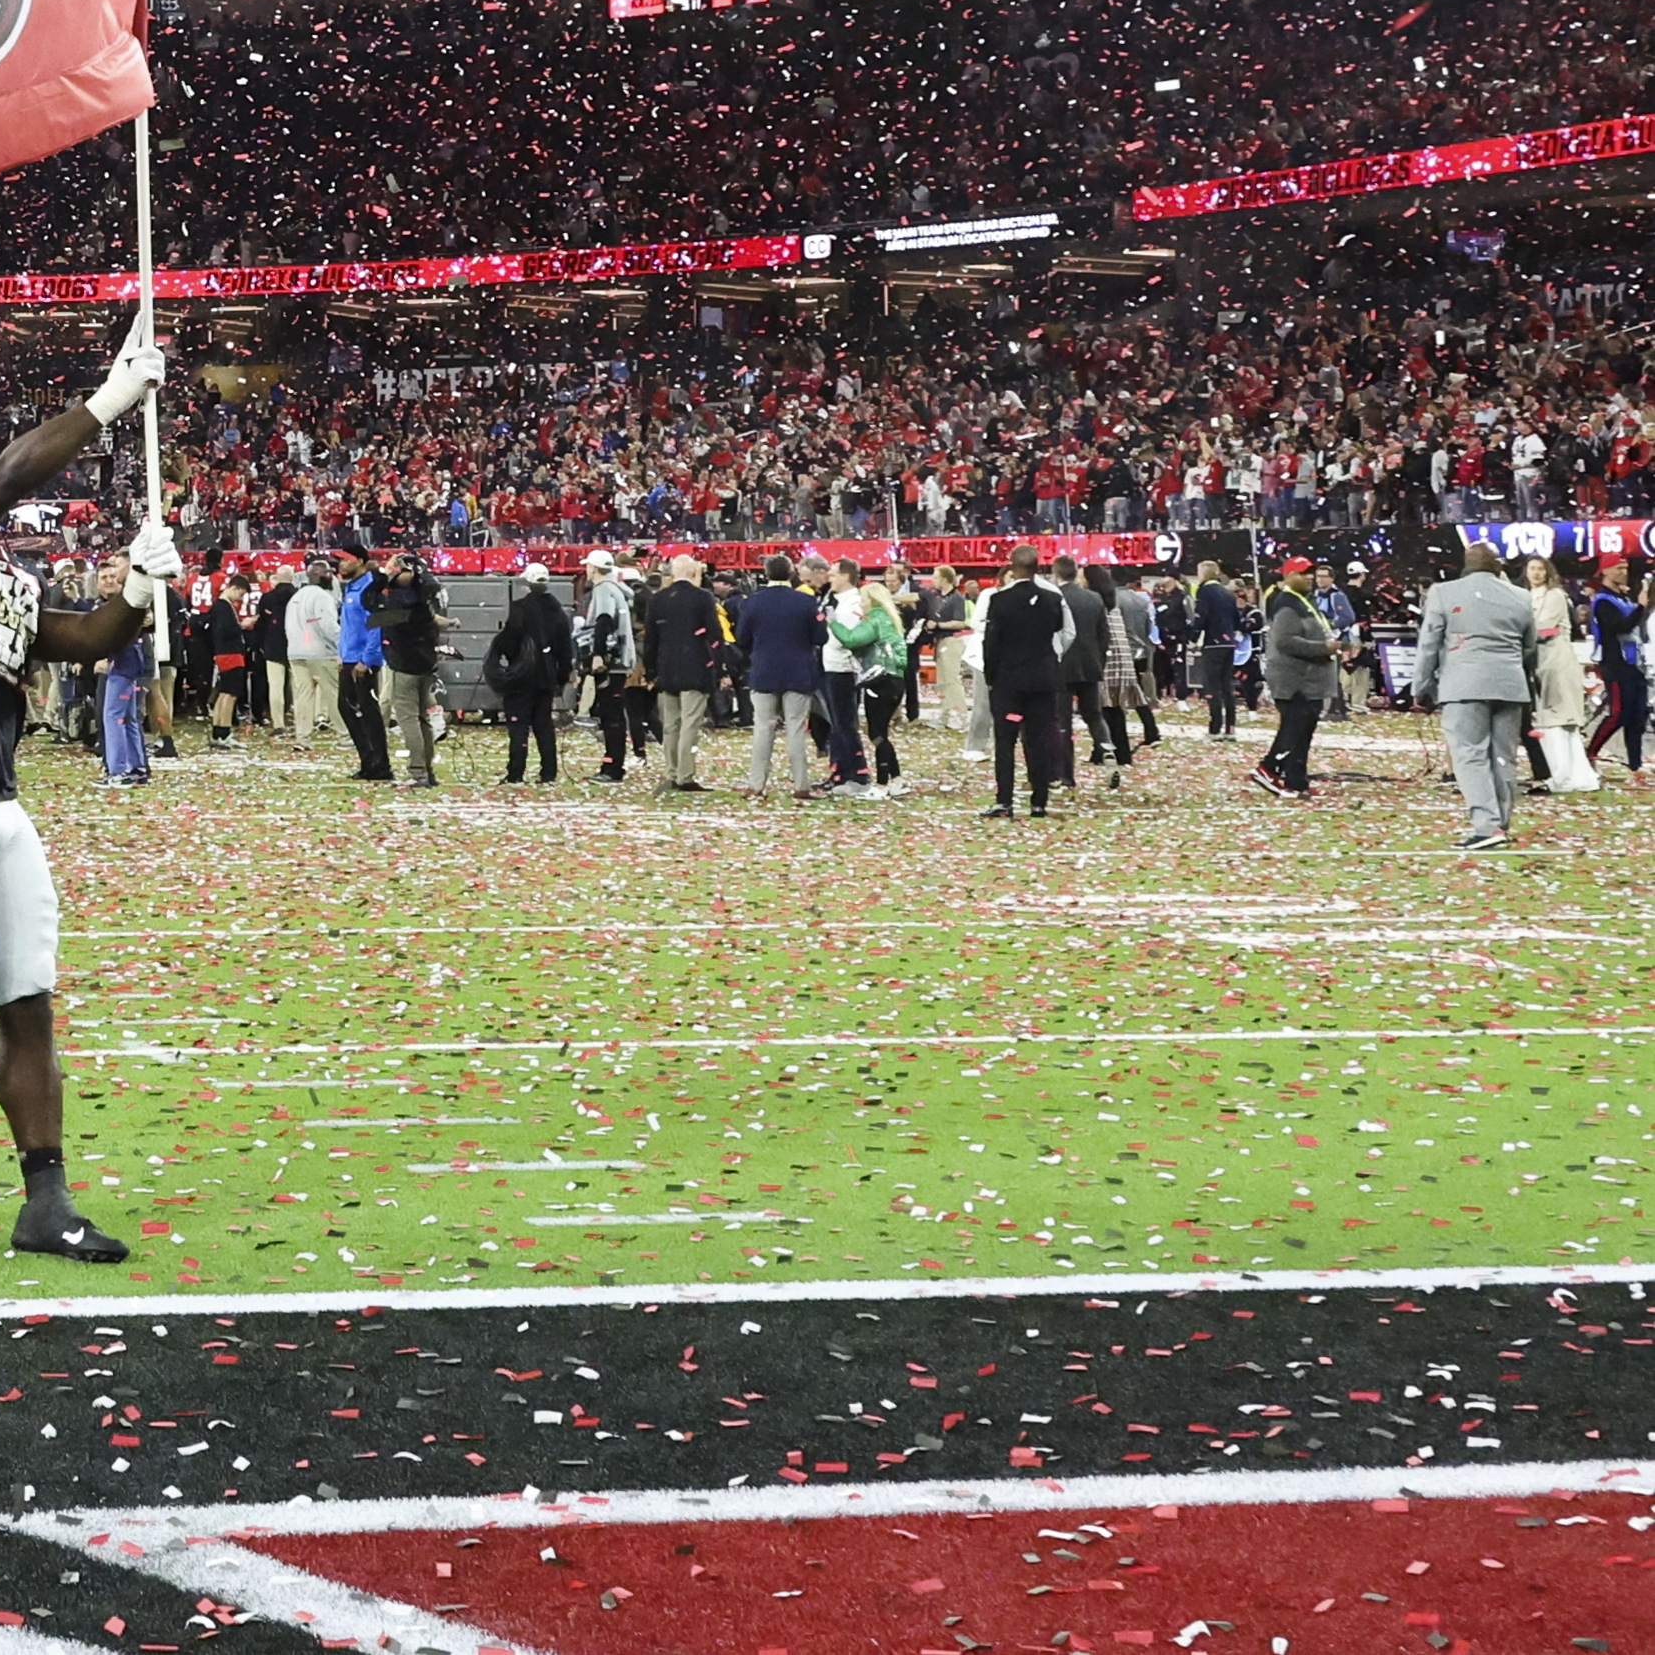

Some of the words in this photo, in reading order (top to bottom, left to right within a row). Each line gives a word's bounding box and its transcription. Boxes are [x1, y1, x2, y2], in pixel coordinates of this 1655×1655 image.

[522, 251, 616, 278] GEORGIA
[1501, 521, 1555, 559] TCU
[1572, 526, 1586, 553] 7
[1599, 526, 1624, 553] 65
[191, 581, 213, 607] 64
